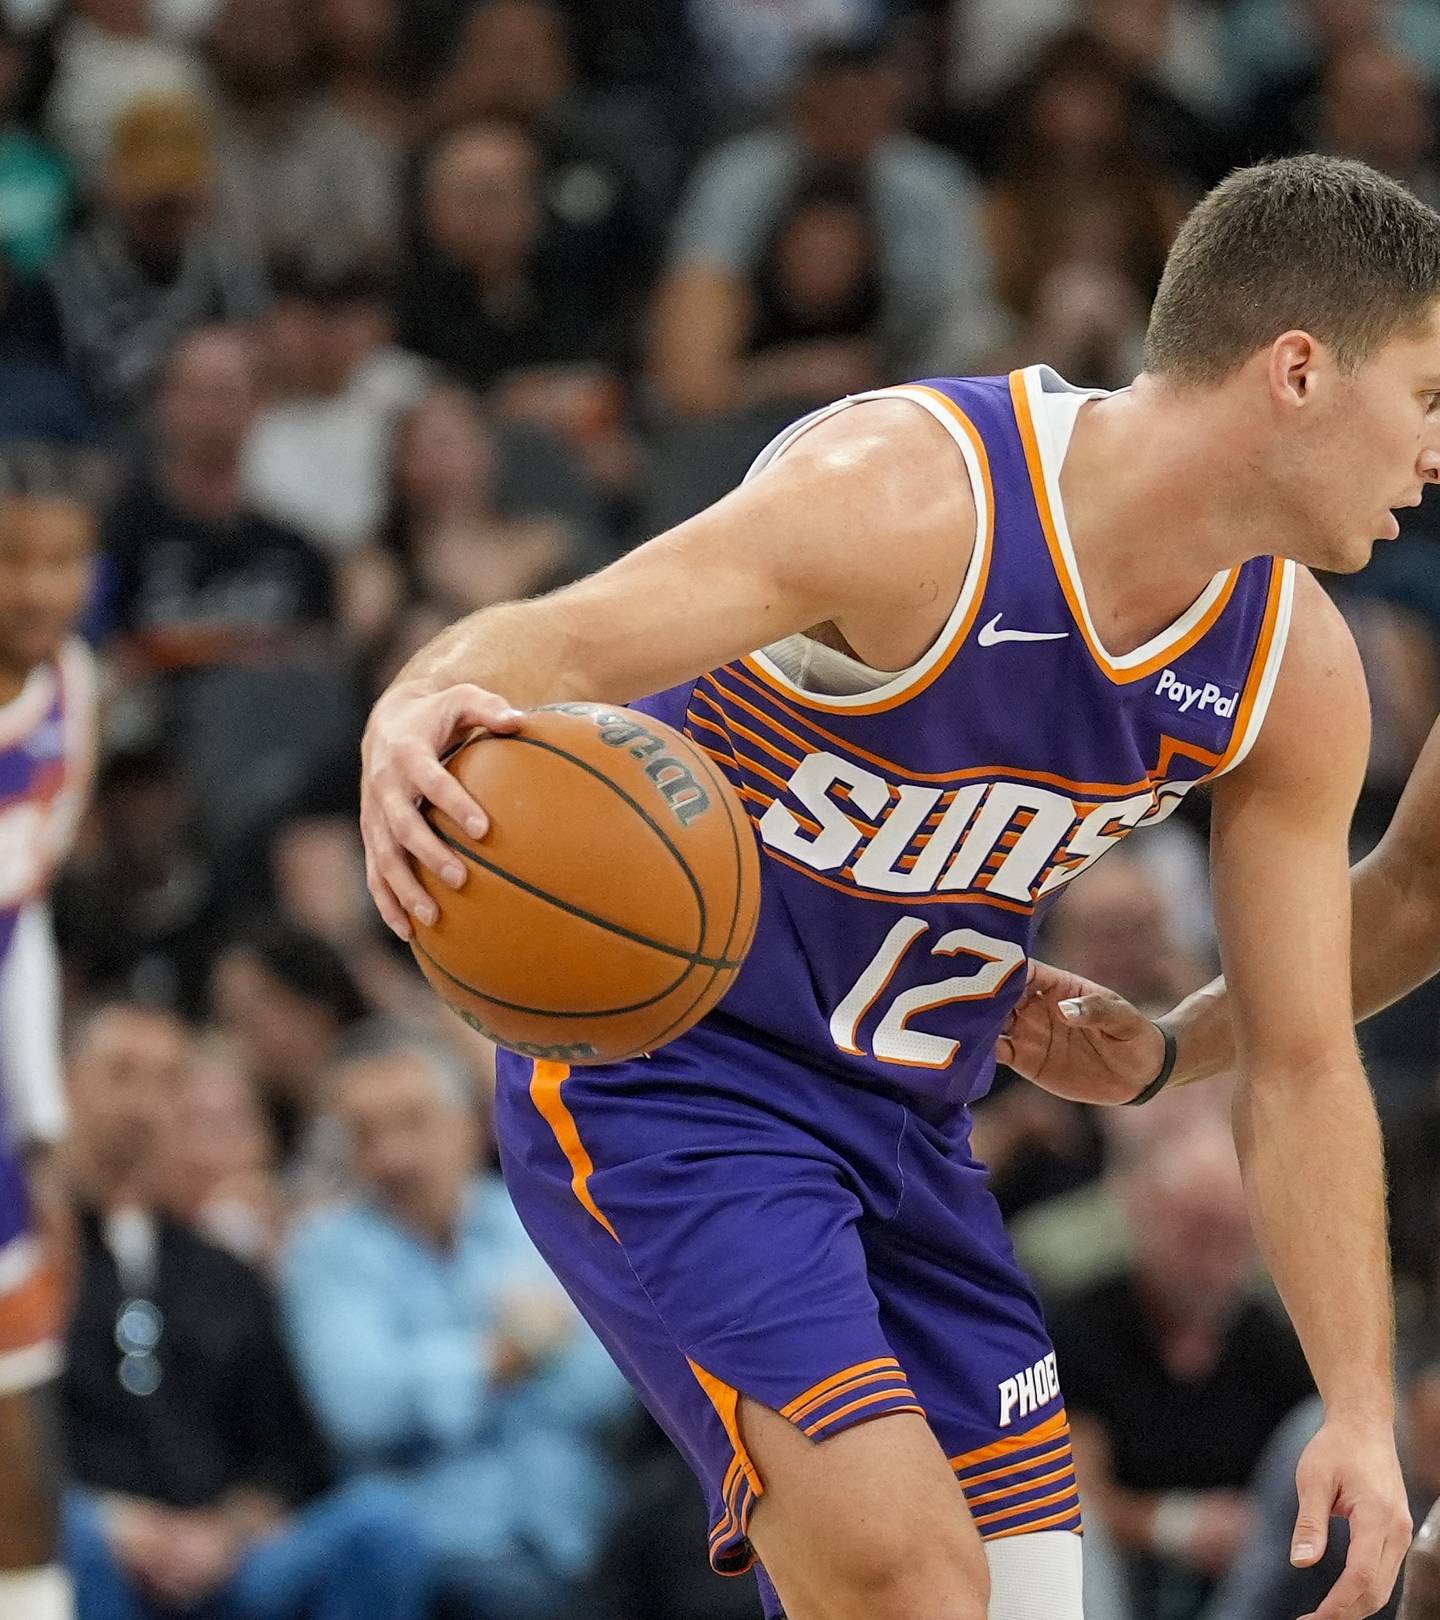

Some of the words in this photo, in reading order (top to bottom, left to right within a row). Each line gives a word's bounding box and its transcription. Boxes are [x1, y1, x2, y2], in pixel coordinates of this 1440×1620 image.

[1154, 668, 1240, 719] PayPal
[759, 751, 1155, 902] SUNS
[829, 914, 1027, 1070] 12
[998, 1351, 1060, 1428] PHOE
